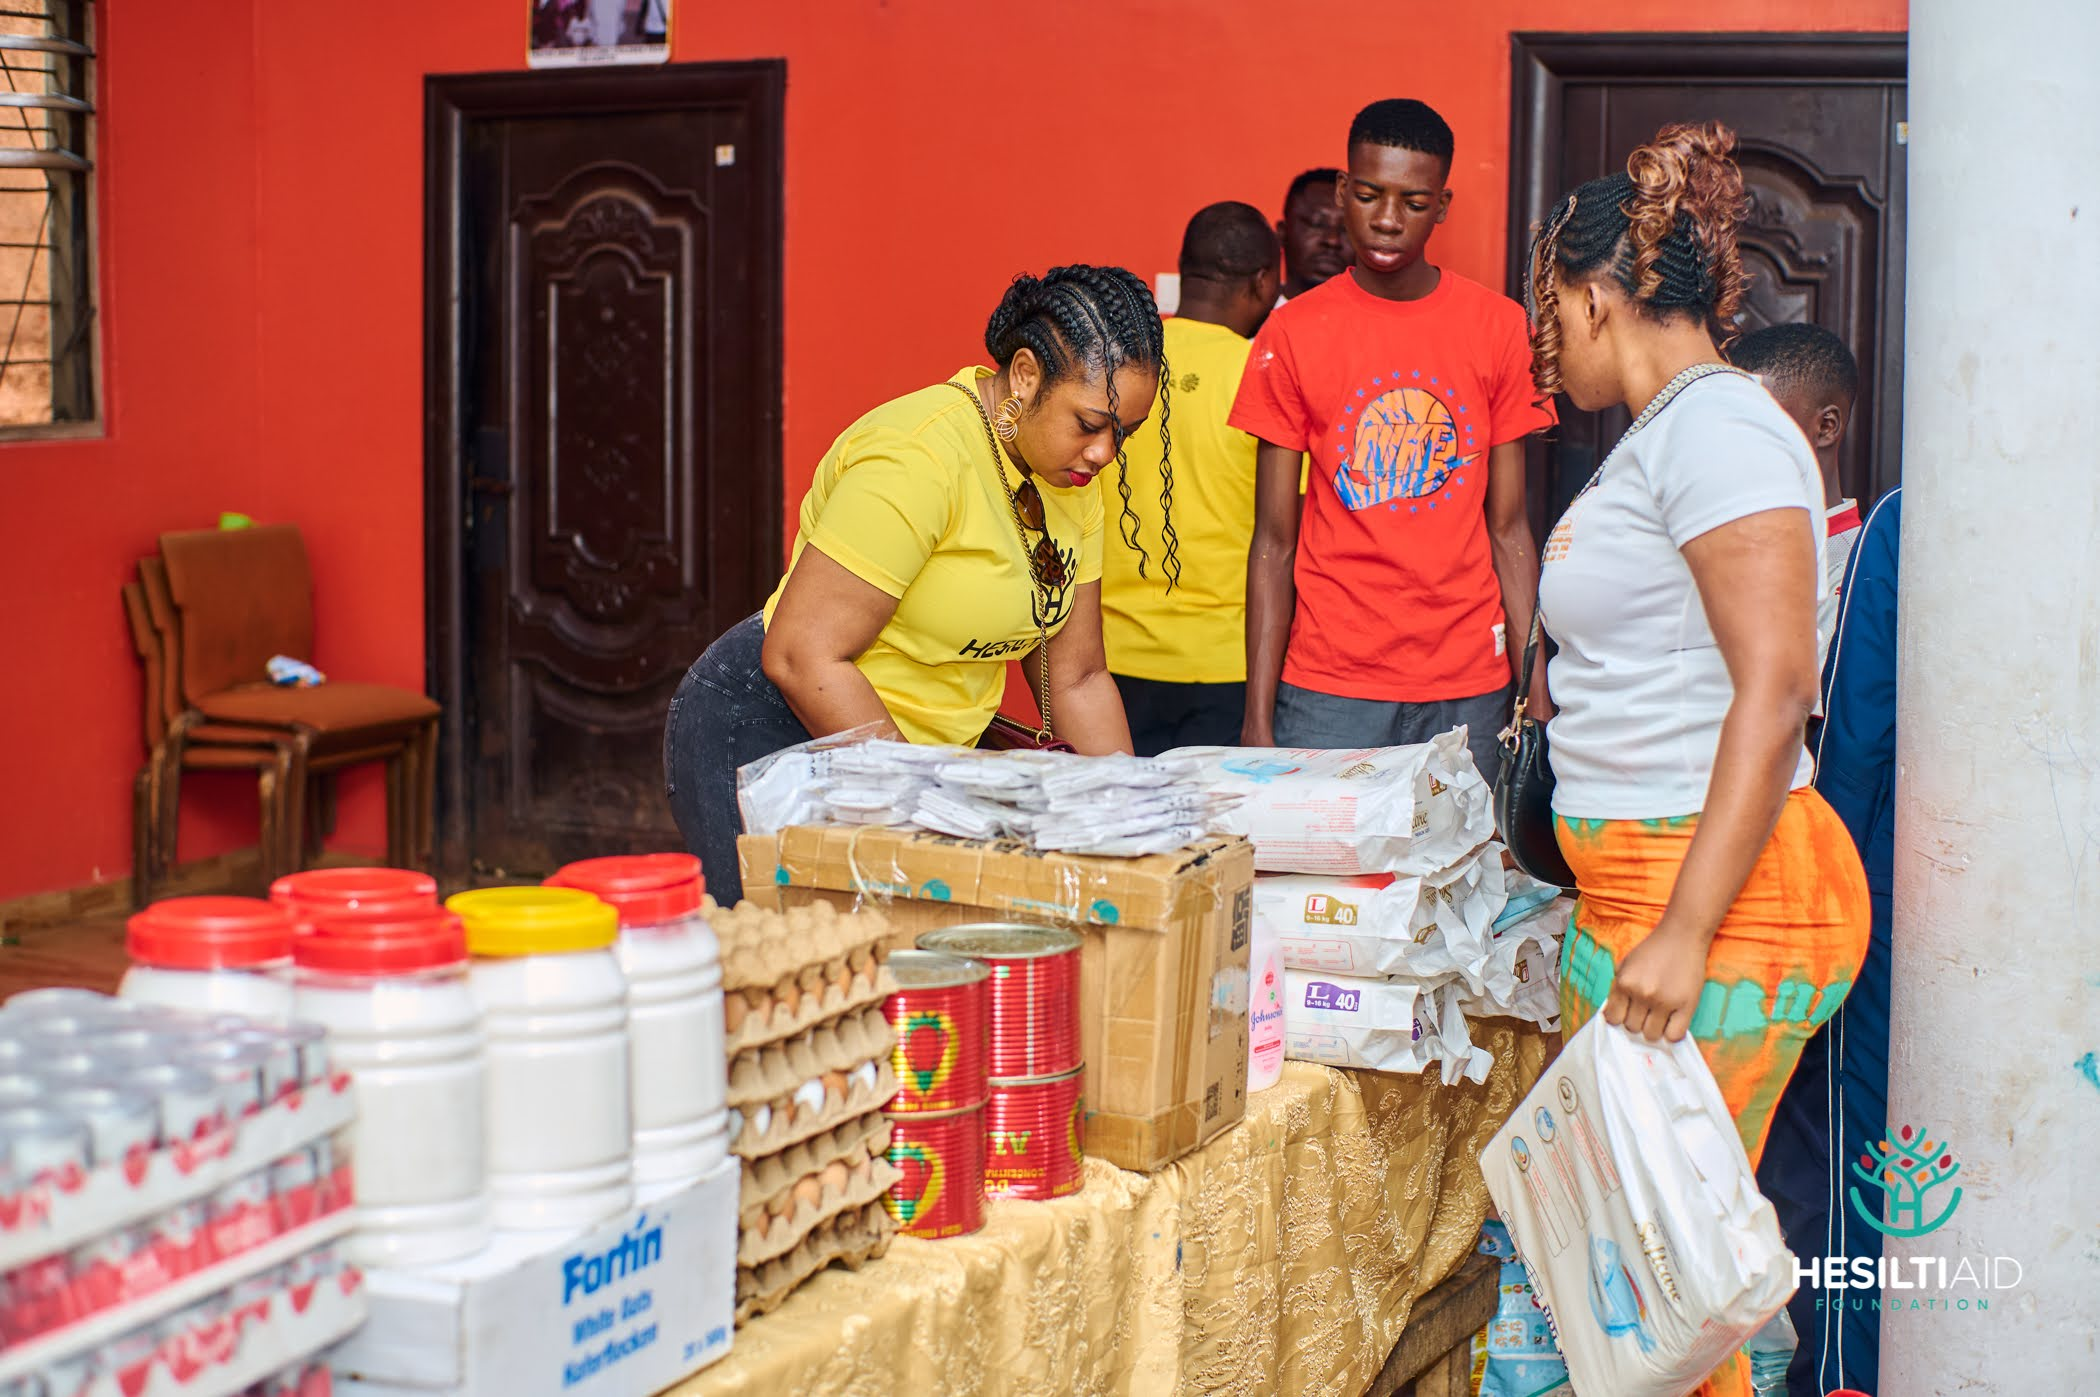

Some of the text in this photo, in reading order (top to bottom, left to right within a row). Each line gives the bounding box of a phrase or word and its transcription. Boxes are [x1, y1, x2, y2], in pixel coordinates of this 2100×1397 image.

[1351, 422, 1455, 480] NIKE
[1309, 898, 1325, 912] L
[1334, 907, 1354, 924] 40
[1308, 984, 1330, 1000] L
[1335, 992, 1355, 1010] 40
